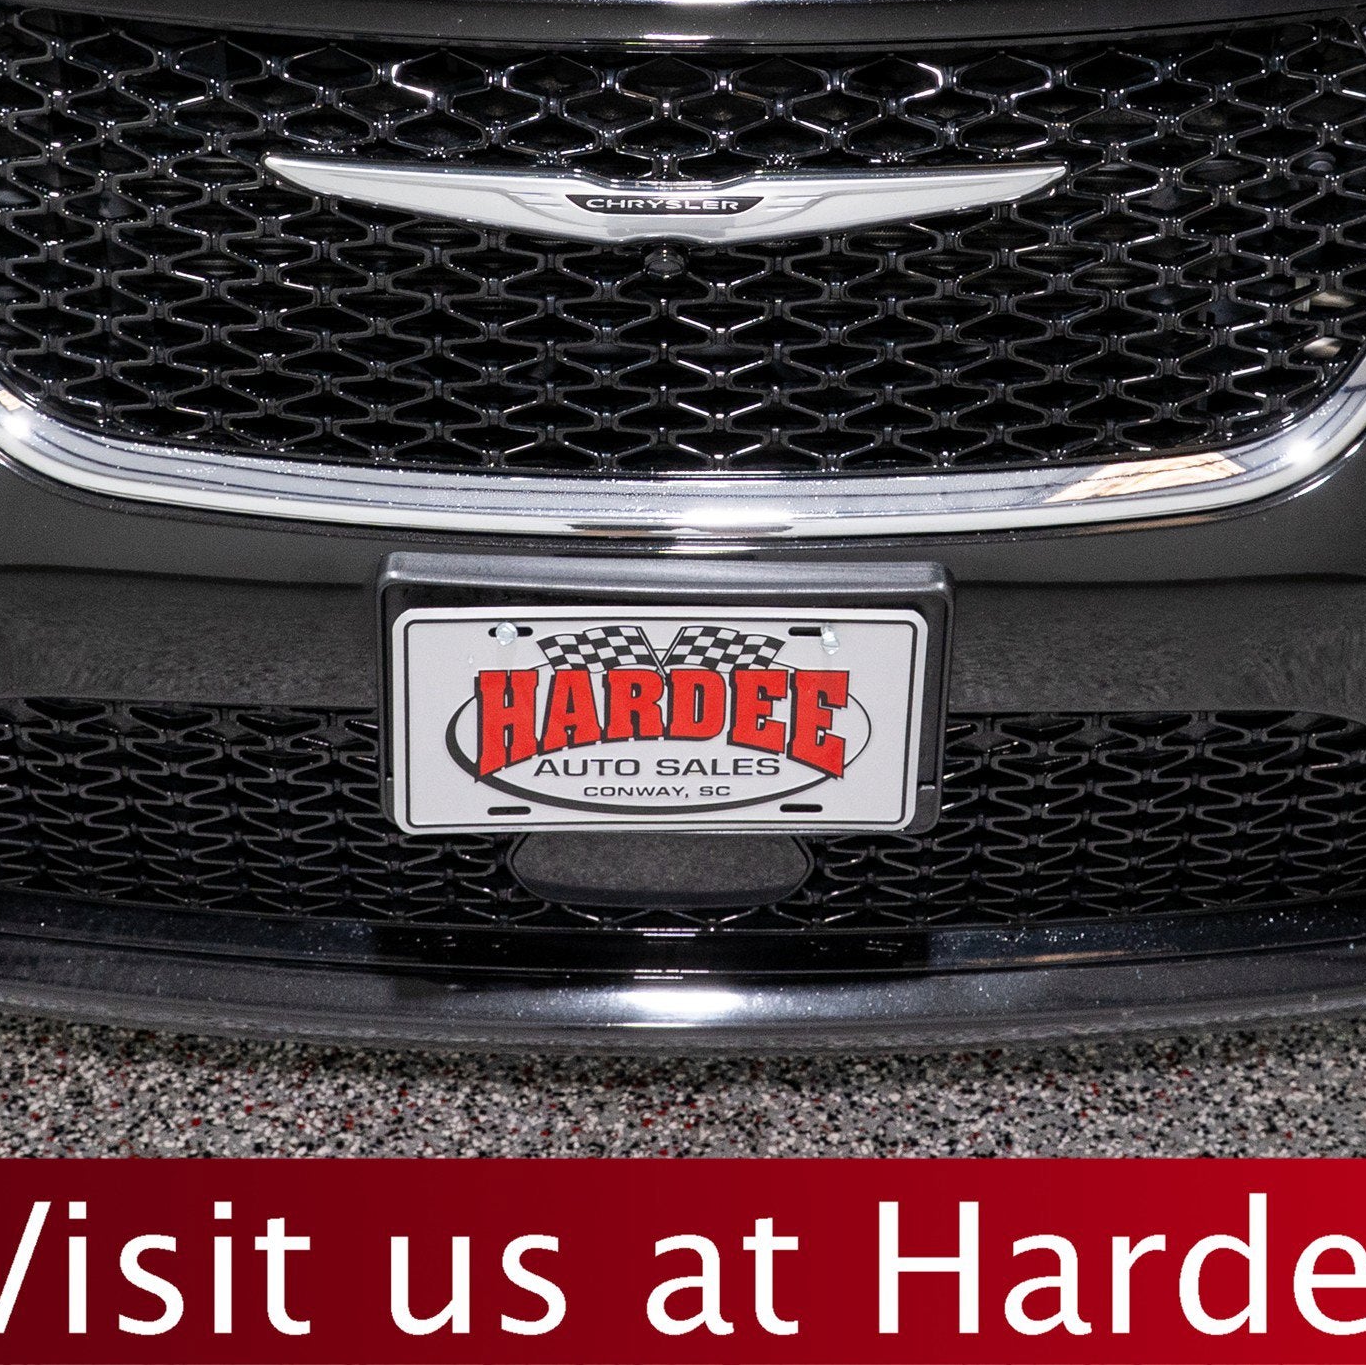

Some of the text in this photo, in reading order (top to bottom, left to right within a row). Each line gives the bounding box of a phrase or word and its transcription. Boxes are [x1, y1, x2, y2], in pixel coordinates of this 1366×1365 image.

[585, 198, 739, 211] CHRYSLER
[474, 669, 849, 782] HARDEE
[533, 757, 781, 778] AUTO SALES
[582, 785, 732, 800] CONWAY, SC
